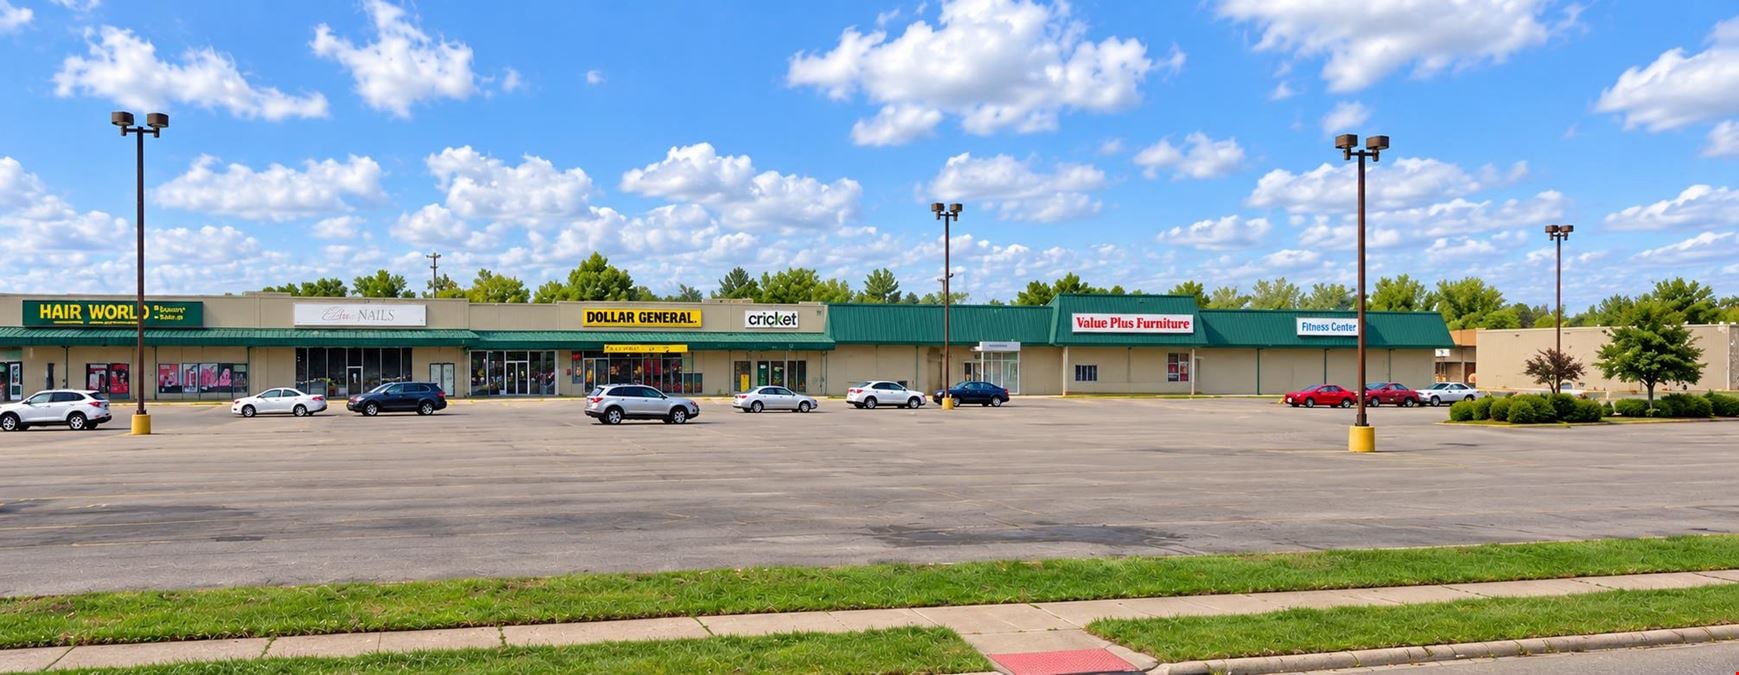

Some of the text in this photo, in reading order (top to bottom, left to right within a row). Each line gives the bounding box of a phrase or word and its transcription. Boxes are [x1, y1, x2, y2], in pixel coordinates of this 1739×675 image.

[40, 304, 82, 320] HAIR
[88, 304, 150, 320] WORLD
[358, 309, 394, 321] NAILS
[586, 312, 634, 323] DOLLAR
[748, 312, 797, 326] cricket
[1076, 316, 1190, 330] Value Plus Furniture
[1302, 322, 1356, 332] Fitness Center
